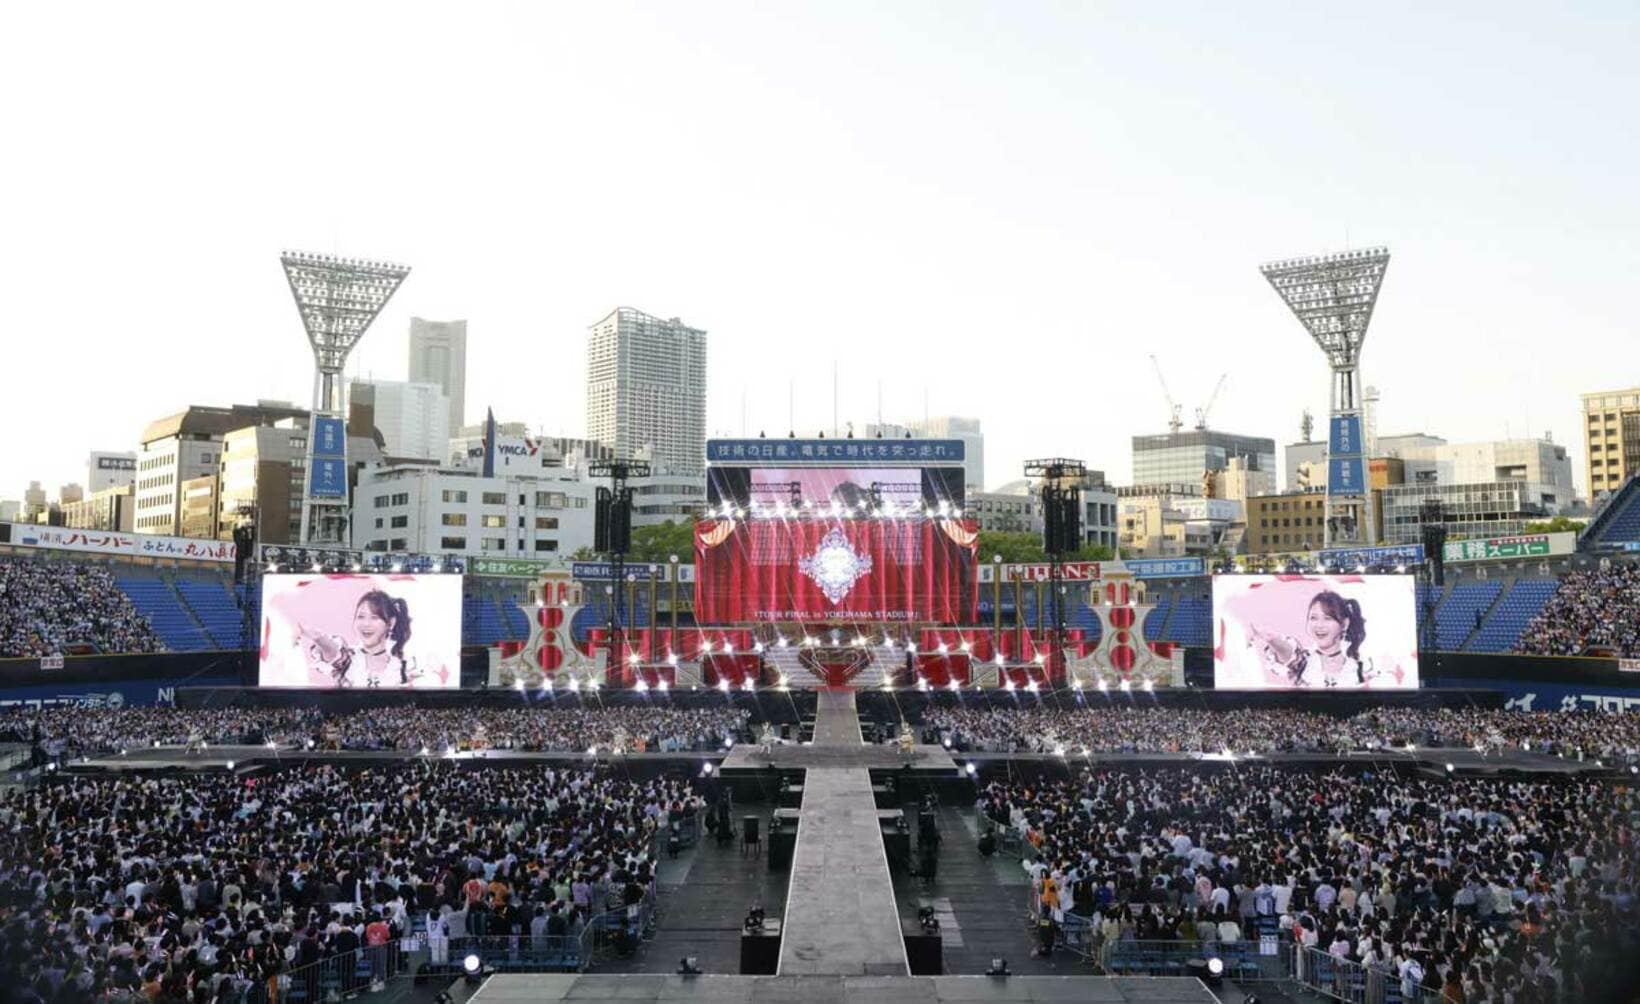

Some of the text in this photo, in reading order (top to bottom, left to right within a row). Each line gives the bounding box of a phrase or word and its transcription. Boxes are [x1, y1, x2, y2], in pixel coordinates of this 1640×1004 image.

[497, 445, 528, 456] YMCA
[1445, 541, 1544, 560] 業務スーパー
[824, 610, 873, 618] YOKOHAMA
